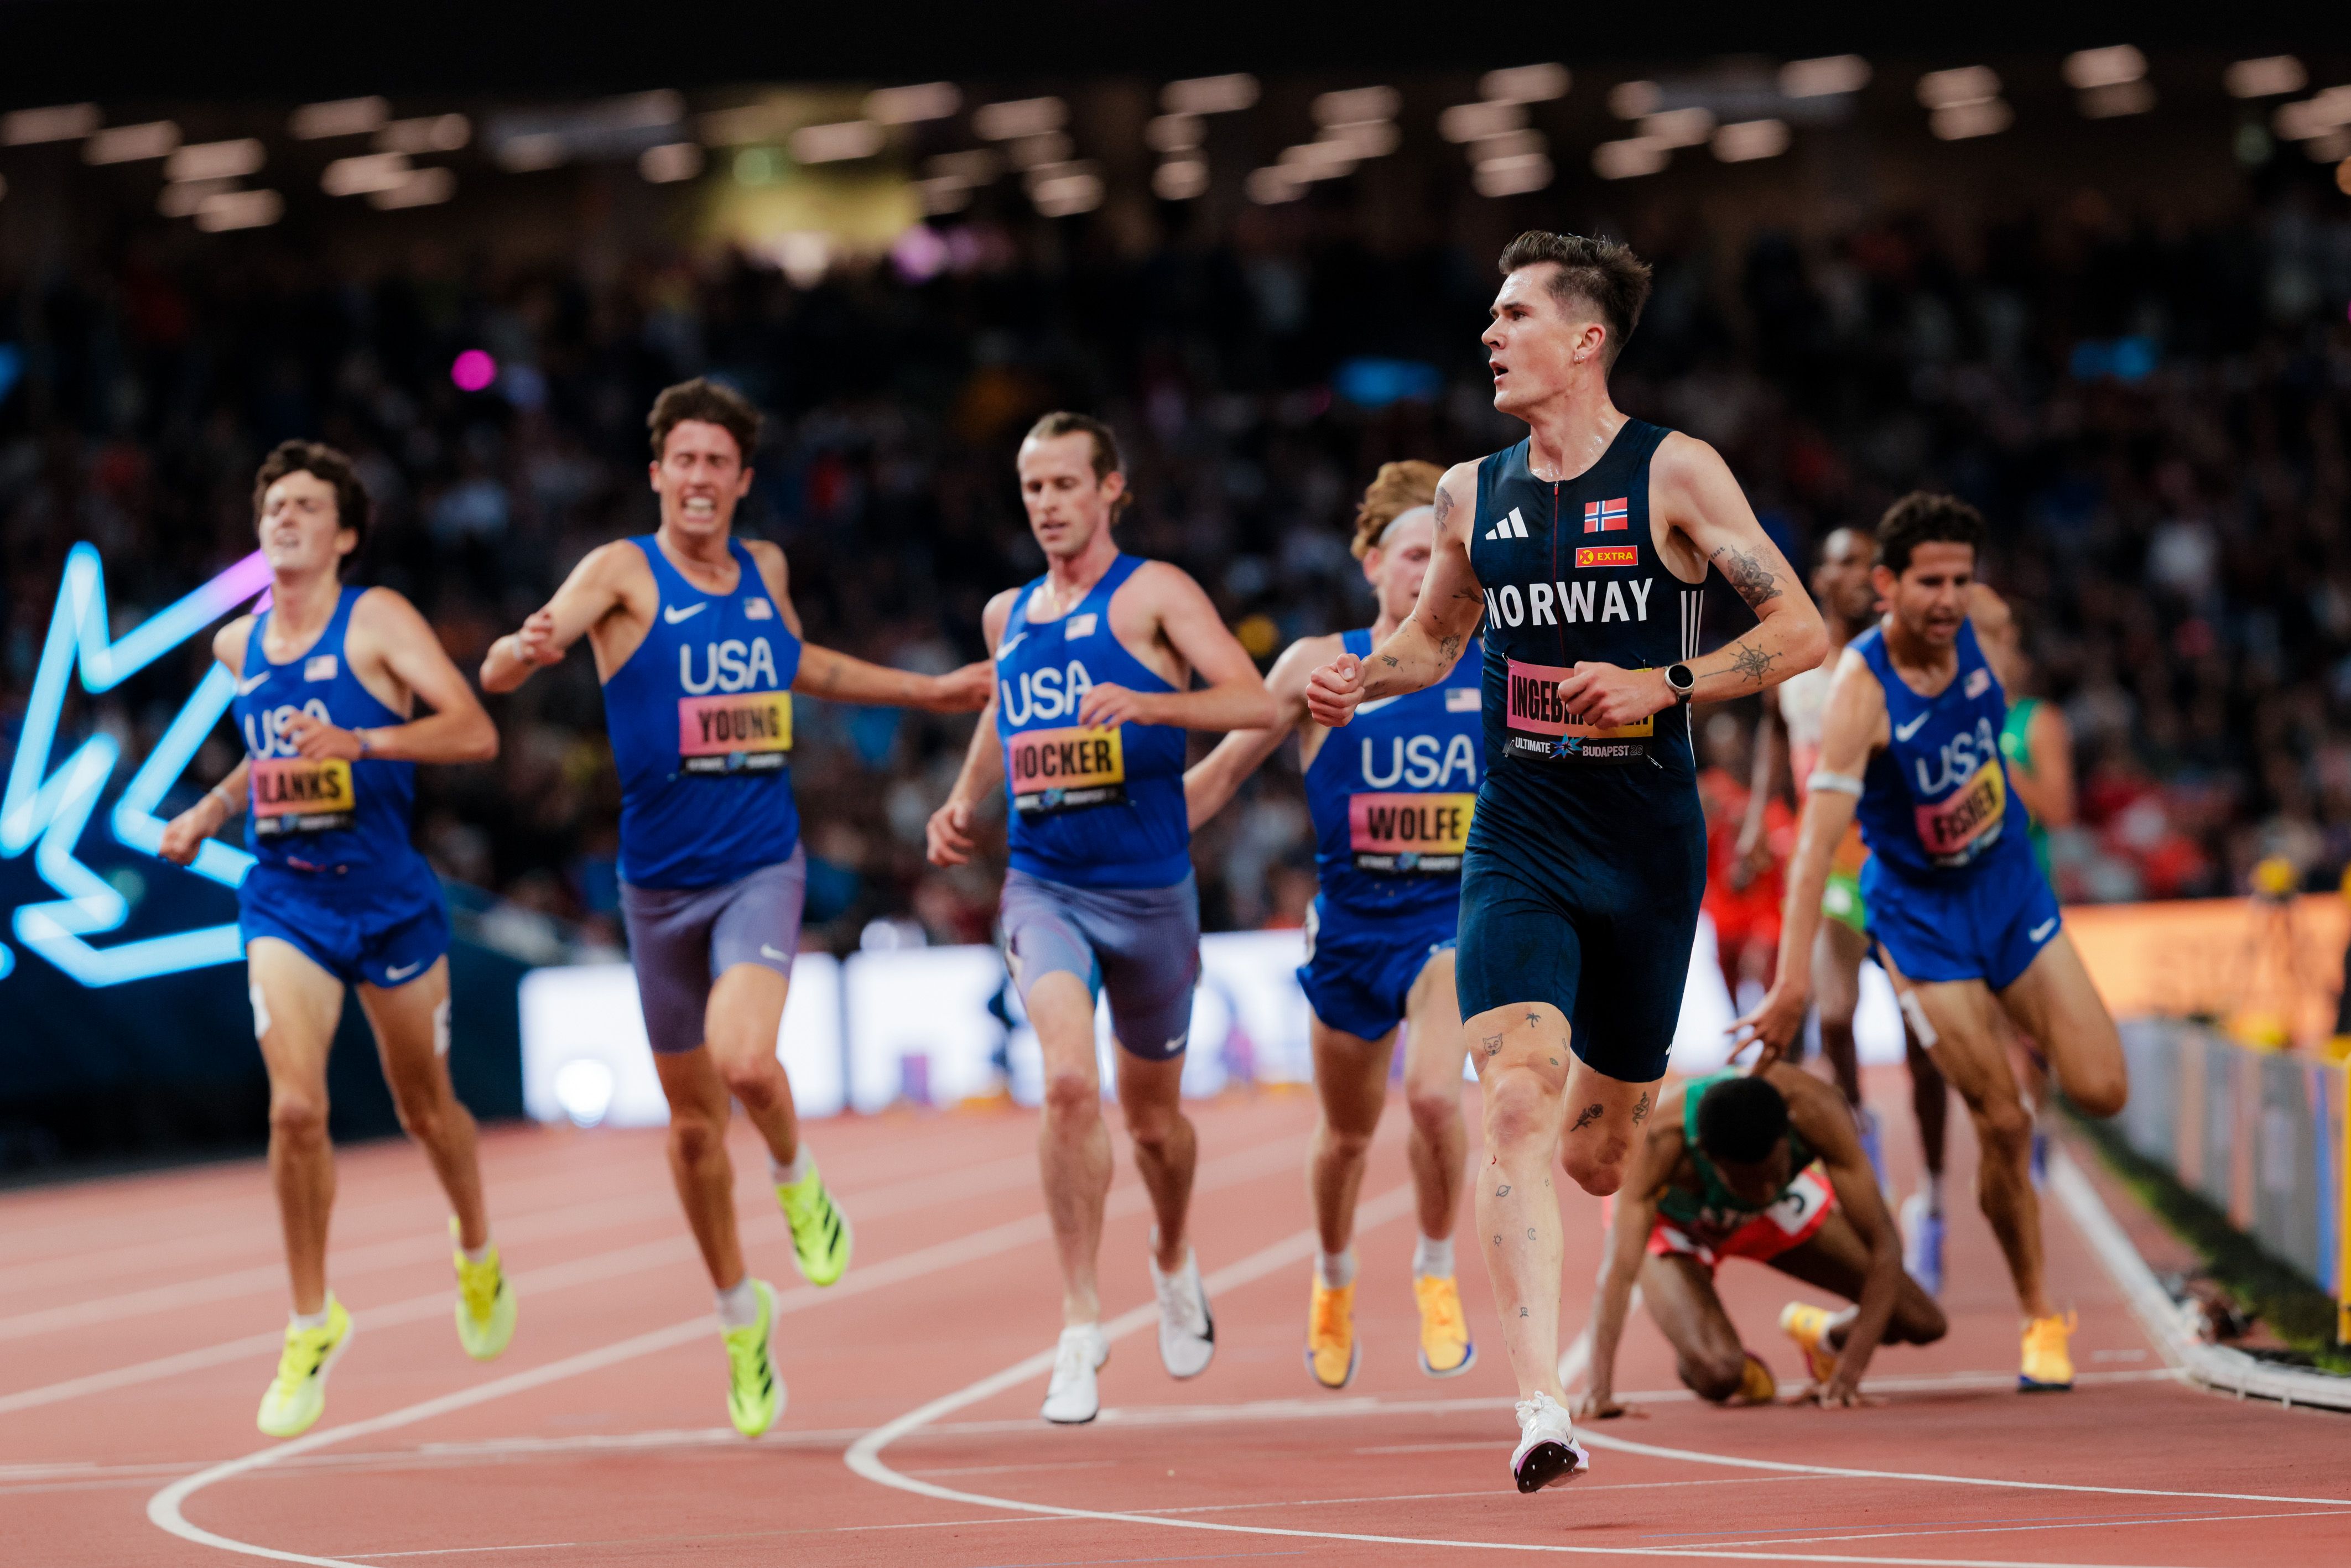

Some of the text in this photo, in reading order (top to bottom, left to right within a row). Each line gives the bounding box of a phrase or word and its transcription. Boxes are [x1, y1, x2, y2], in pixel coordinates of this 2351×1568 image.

[1597, 551, 1634, 561] EXTRA
[1484, 577, 1654, 629] NORWAY
[680, 637, 778, 695] USA
[1001, 659, 1093, 727] USA
[1361, 734, 1476, 789] USA
[1515, 736, 1643, 757] ULTIMATE BUDAPEST 26
[1915, 717, 1999, 796] USA
[1367, 806, 1462, 841] WOLFE
